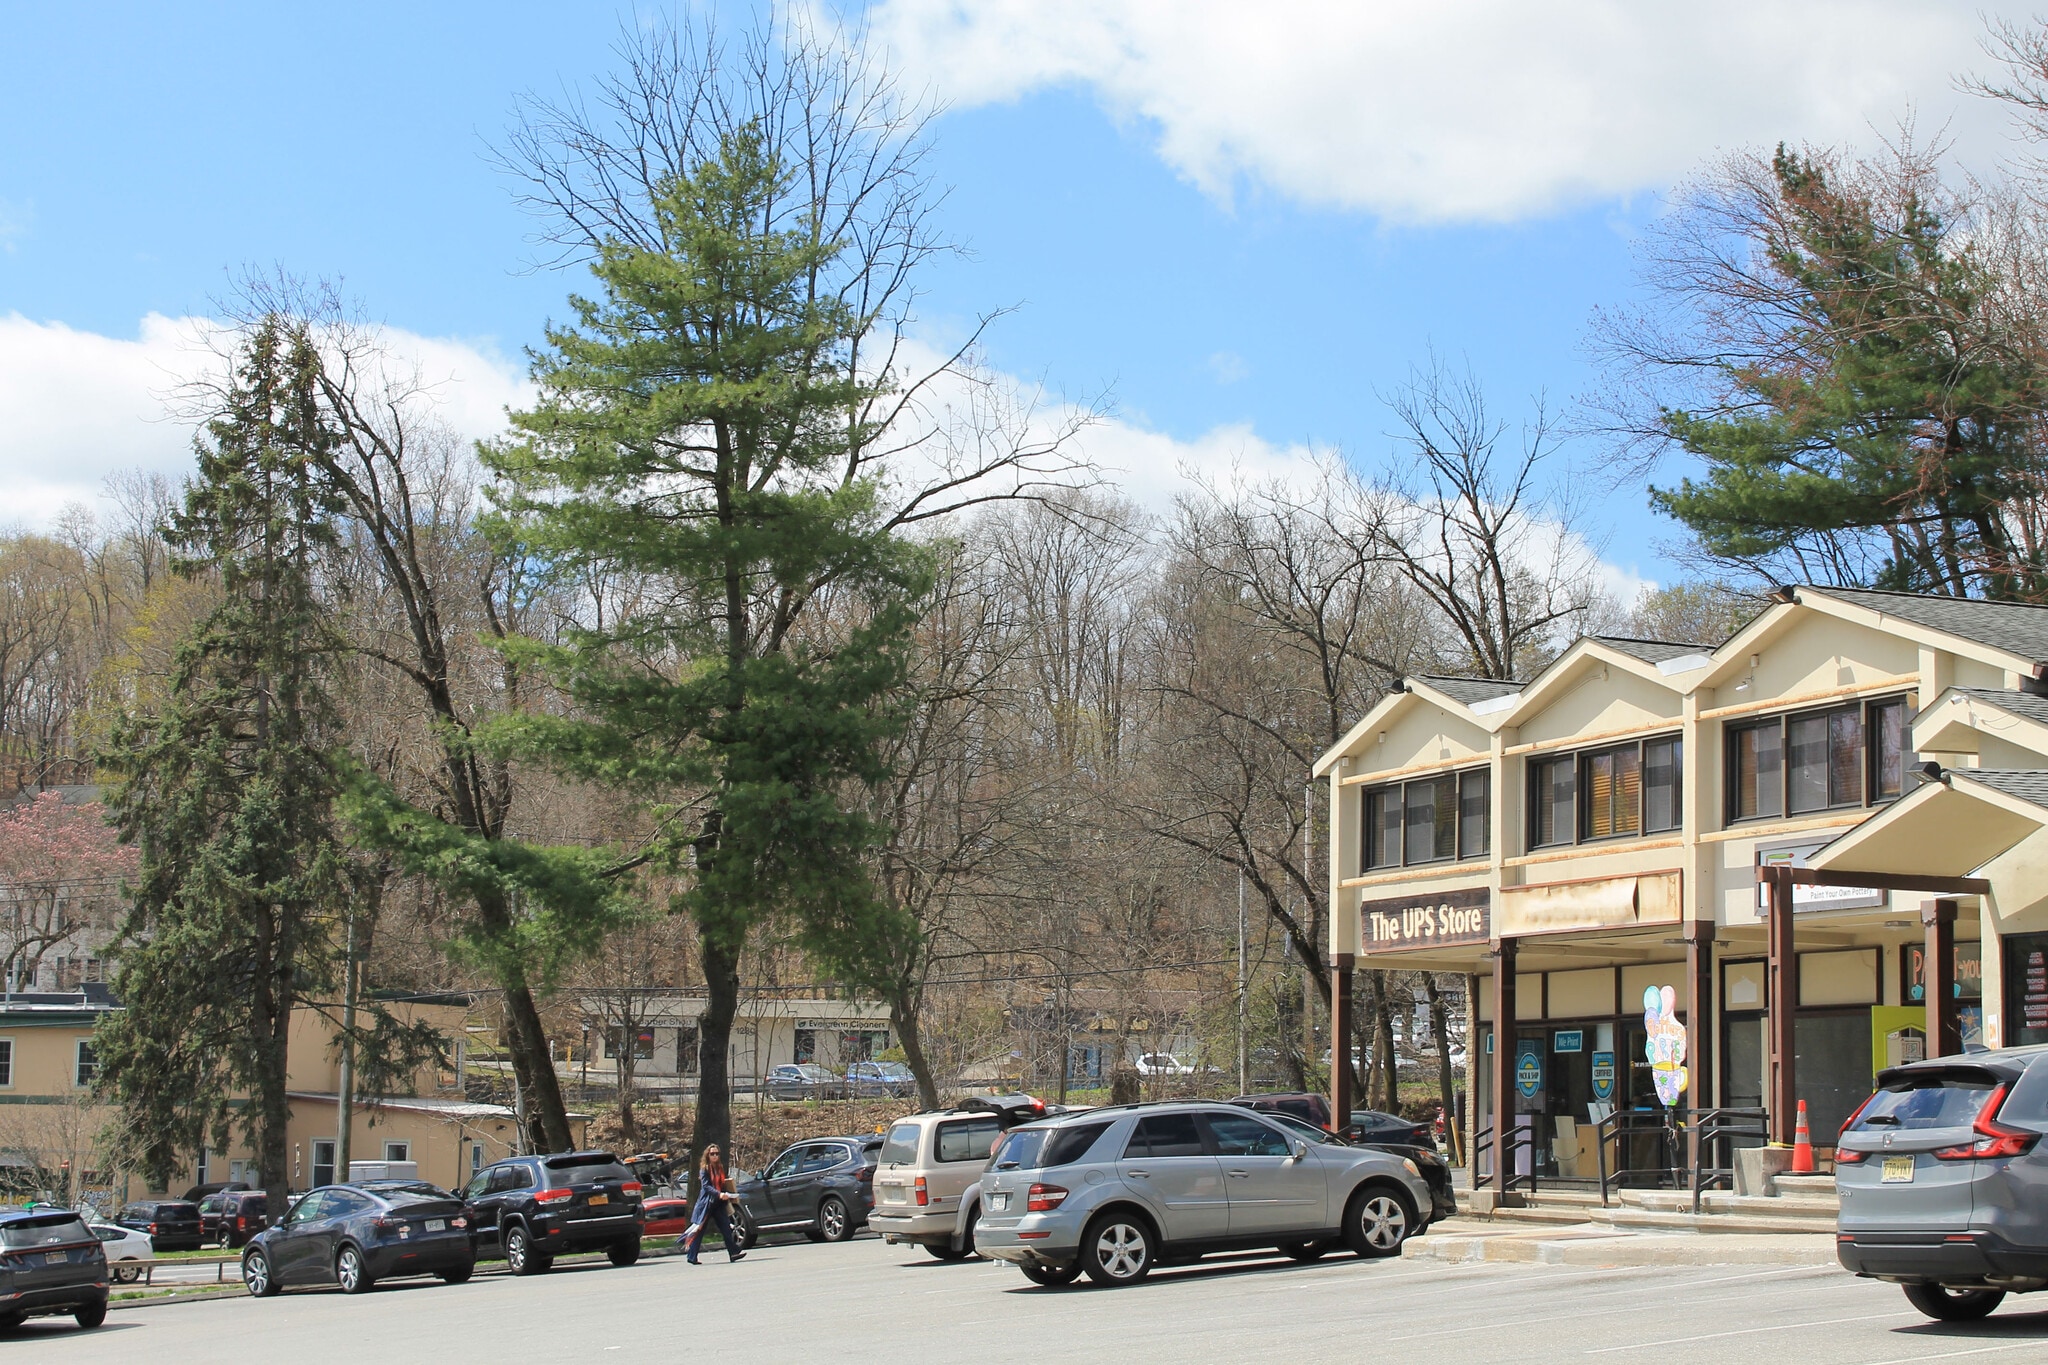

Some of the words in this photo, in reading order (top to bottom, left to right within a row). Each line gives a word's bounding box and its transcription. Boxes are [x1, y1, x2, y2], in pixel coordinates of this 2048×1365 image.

[1810, 890, 1825, 899] Paint
[1826, 889, 1838, 898] Your
[1839, 888, 1851, 897] Own
[1851, 887, 1873, 896] Pottery
[1369, 911, 1400, 941] The
[1402, 905, 1435, 938] UPS
[1438, 904, 1482, 935] Store
[669, 1017, 692, 1027] Shop
[809, 1019, 849, 1029] Evergreen
[850, 1020, 885, 1029] Cleaners
[1558, 1036, 1567, 1046] We
[1567, 1036, 1579, 1046] Print
[1594, 1068, 1612, 1077] CERTIFIED
[0, 1195, 32, 1204] ANGE
